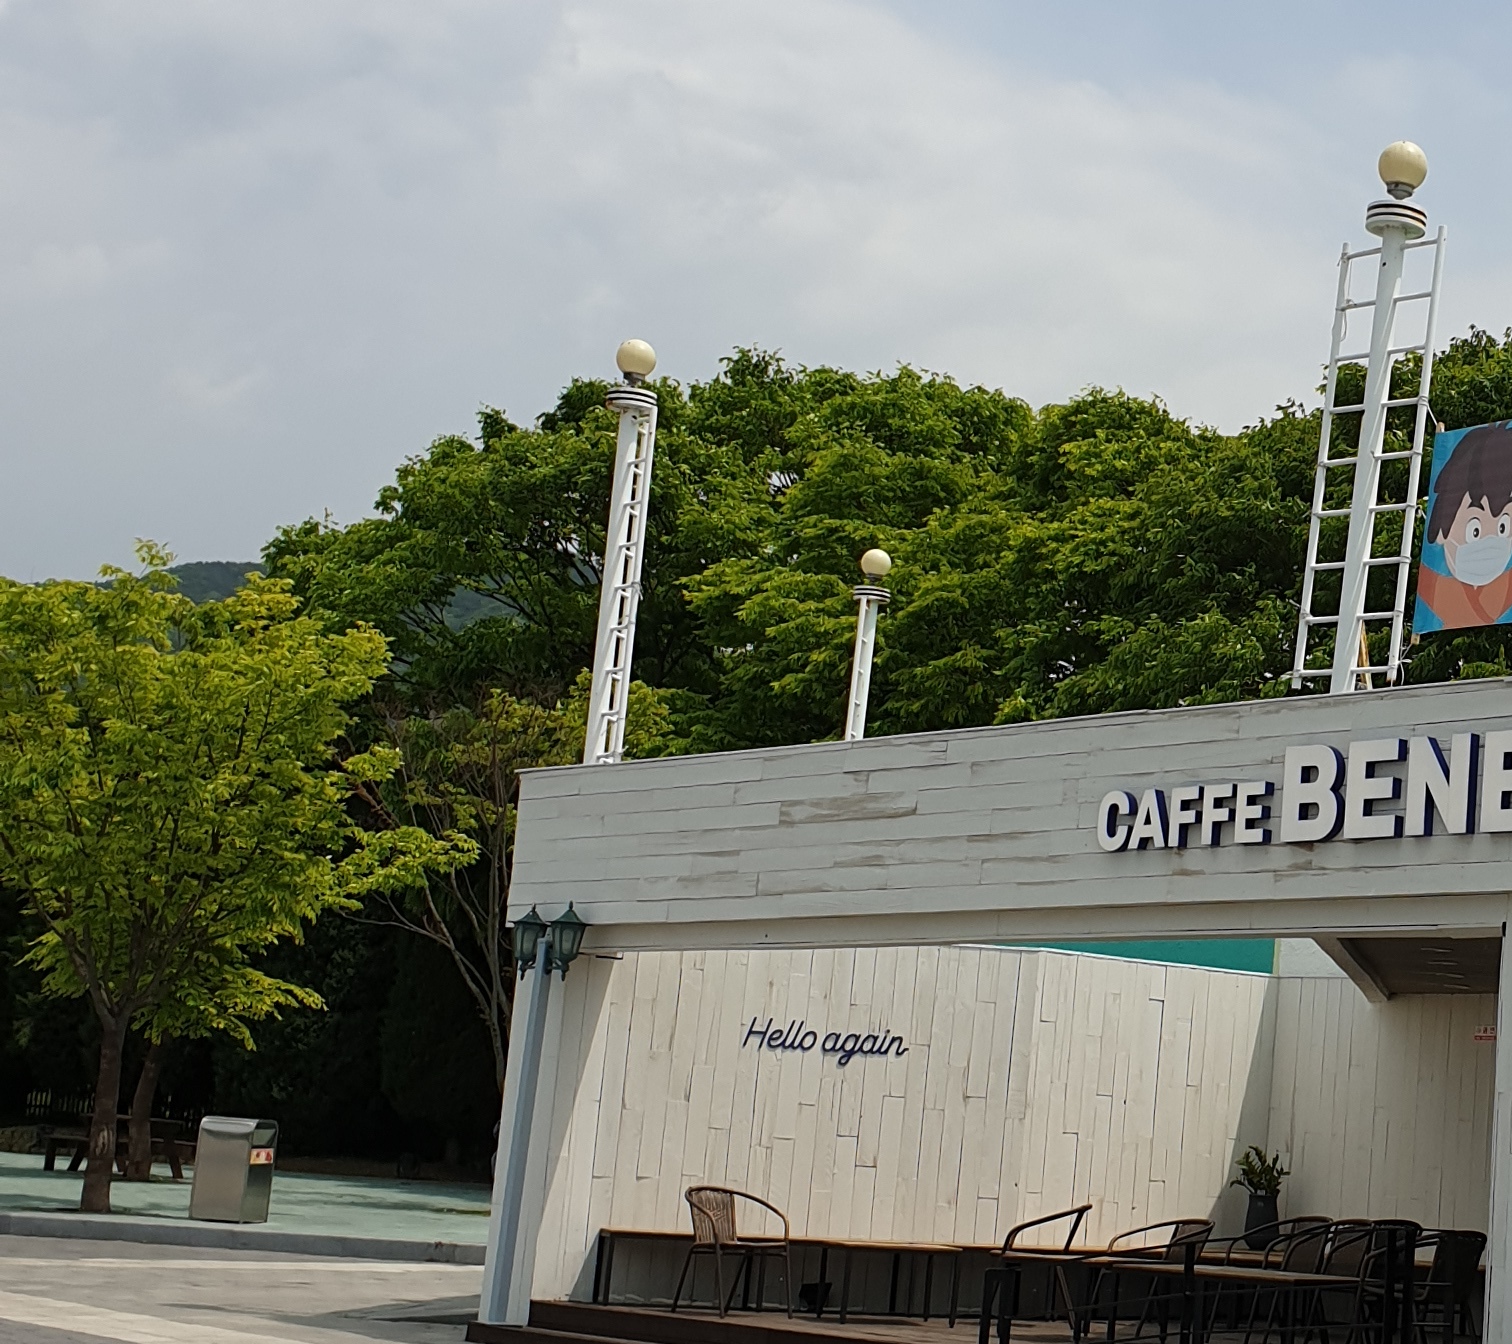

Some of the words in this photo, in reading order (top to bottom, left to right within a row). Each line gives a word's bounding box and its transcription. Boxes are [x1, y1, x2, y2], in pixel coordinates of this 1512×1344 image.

[1097, 780, 1274, 852] CAFFE
[742, 1017, 818, 1051] Hello
[821, 1029, 910, 1066] again
